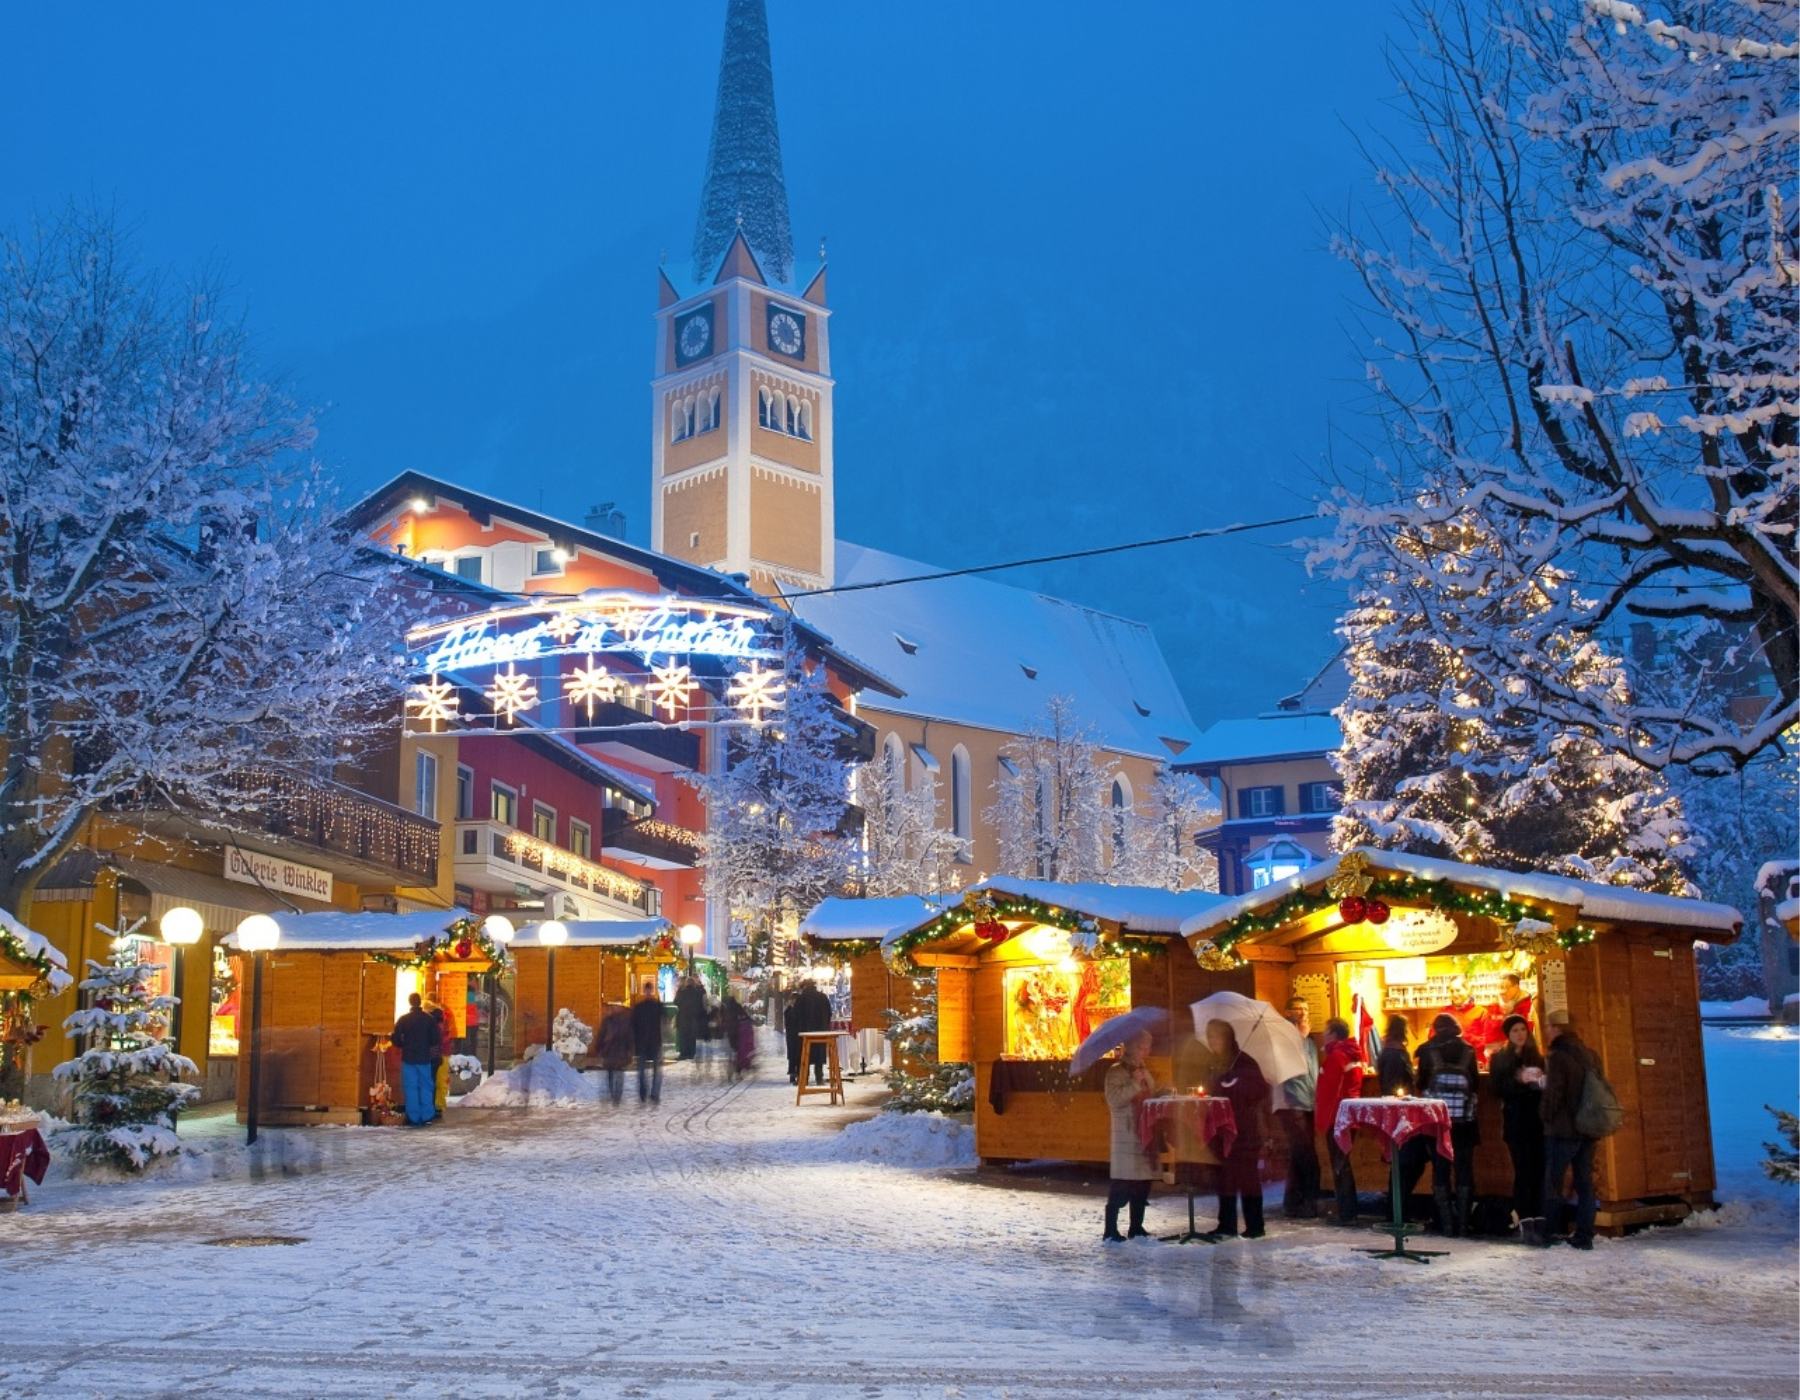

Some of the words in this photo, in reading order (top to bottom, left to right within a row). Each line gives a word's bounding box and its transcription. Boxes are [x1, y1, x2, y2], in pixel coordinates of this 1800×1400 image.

[426, 620, 545, 672] Advent
[577, 621, 607, 652] in
[231, 850, 277, 883] Galerie
[284, 865, 328, 895] Winkler
